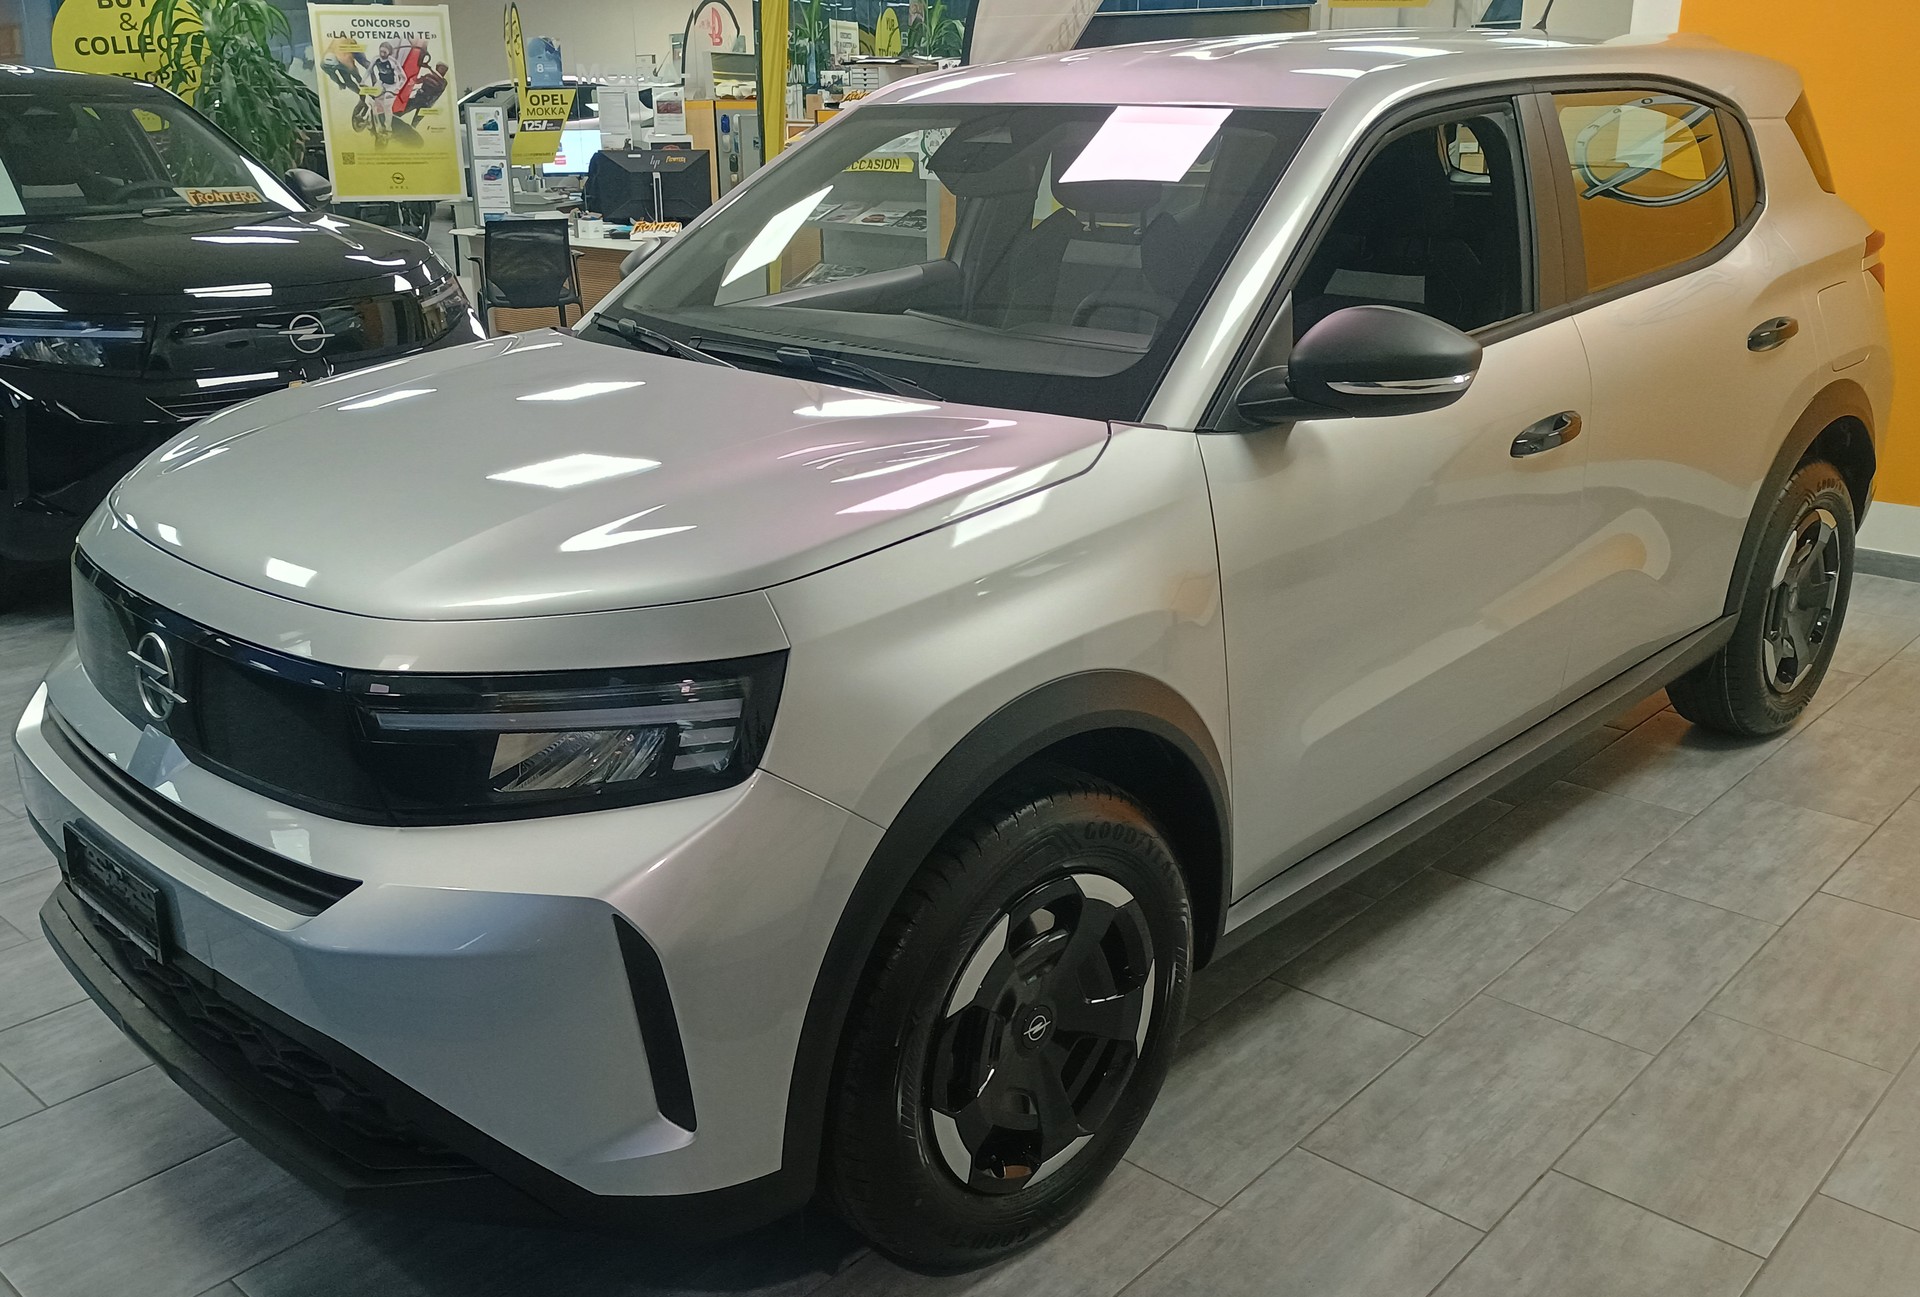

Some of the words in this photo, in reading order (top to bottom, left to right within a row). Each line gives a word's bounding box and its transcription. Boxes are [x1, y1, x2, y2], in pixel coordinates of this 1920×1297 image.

[119, 12, 139, 31] &
[351, 18, 411, 28] CONCORSO
[350, 30, 401, 40] POTENZA
[403, 31, 415, 40] IN
[529, 93, 568, 106] OPEL
[526, 107, 566, 116] MOKKA
[846, 158, 900, 171] CCASION
[186, 189, 262, 205] FRONTERA
[631, 221, 681, 235] FRONTERA
